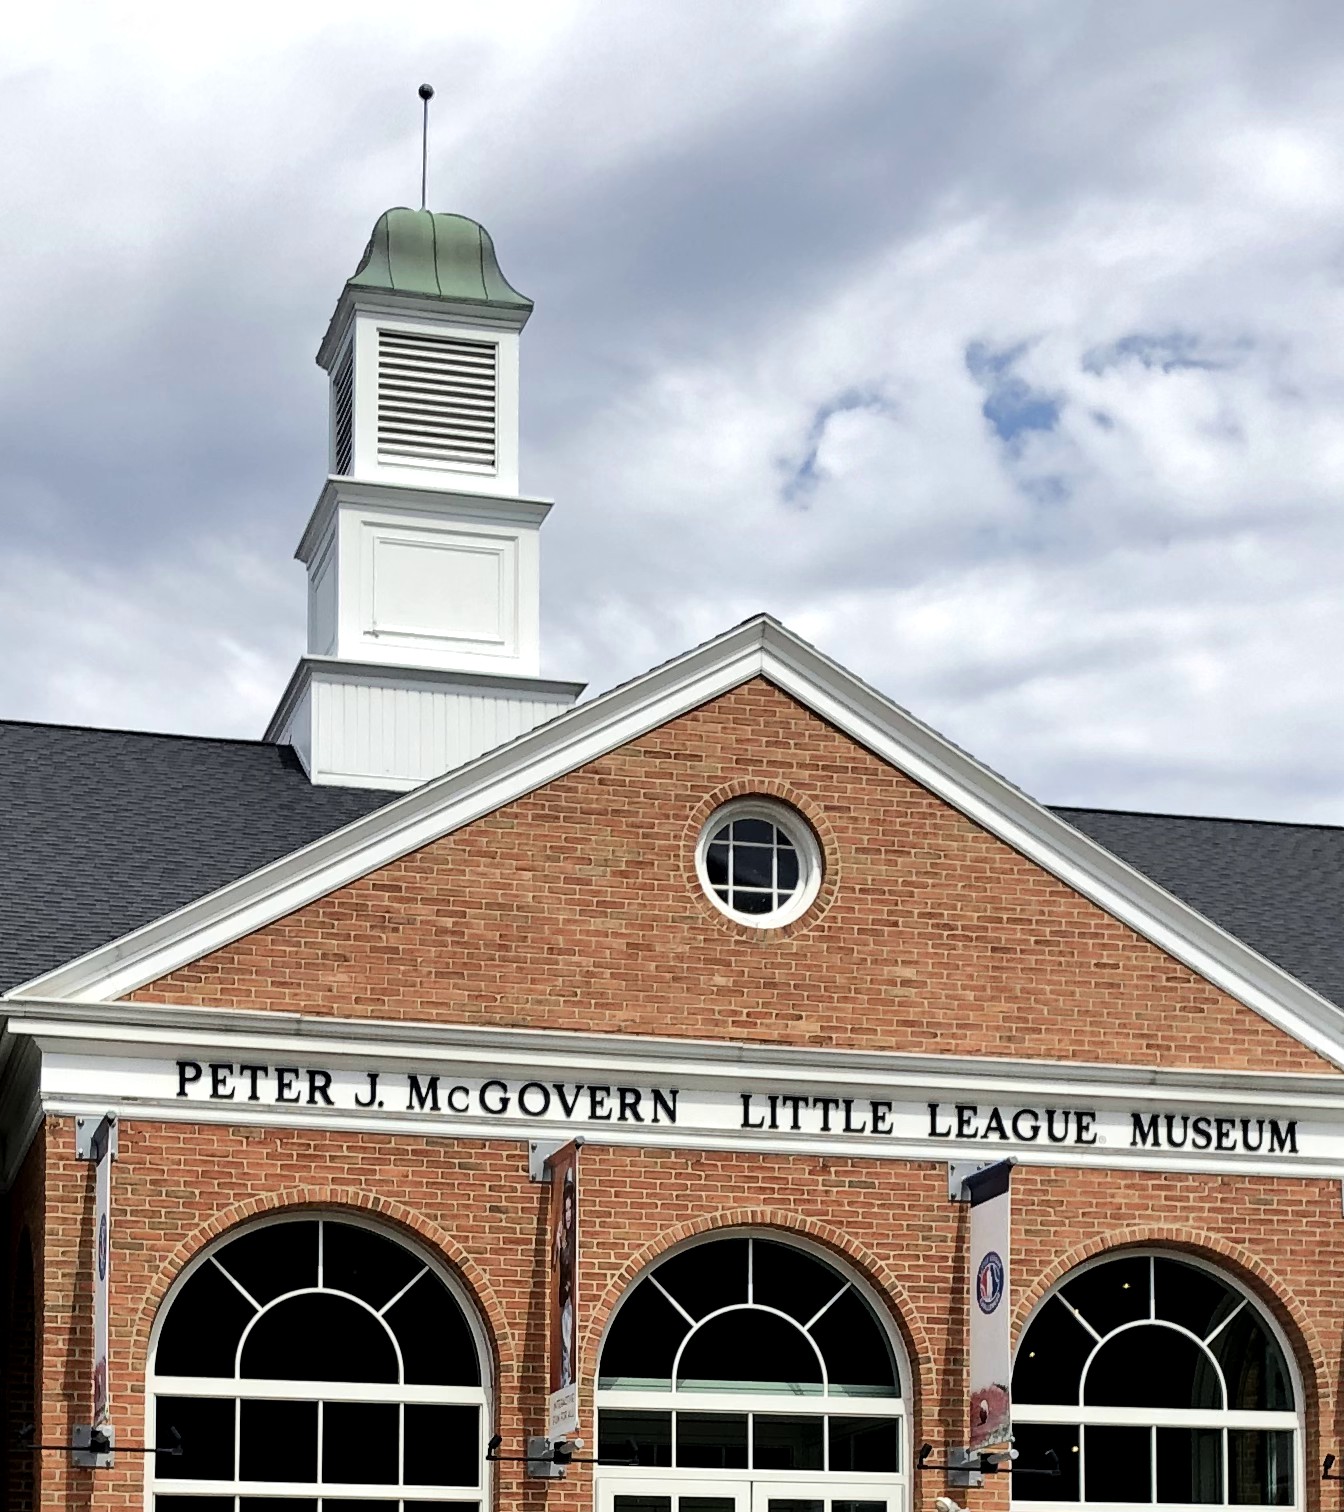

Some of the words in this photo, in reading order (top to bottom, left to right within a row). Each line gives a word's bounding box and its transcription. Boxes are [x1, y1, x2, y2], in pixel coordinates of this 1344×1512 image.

[175, 1060, 335, 1107] PETER
[354, 1072, 385, 1109] J.
[740, 1093, 894, 1136] LITTLE
[927, 1102, 1098, 1146] LEAGUE
[1129, 1112, 1299, 1154] MUSEUM
